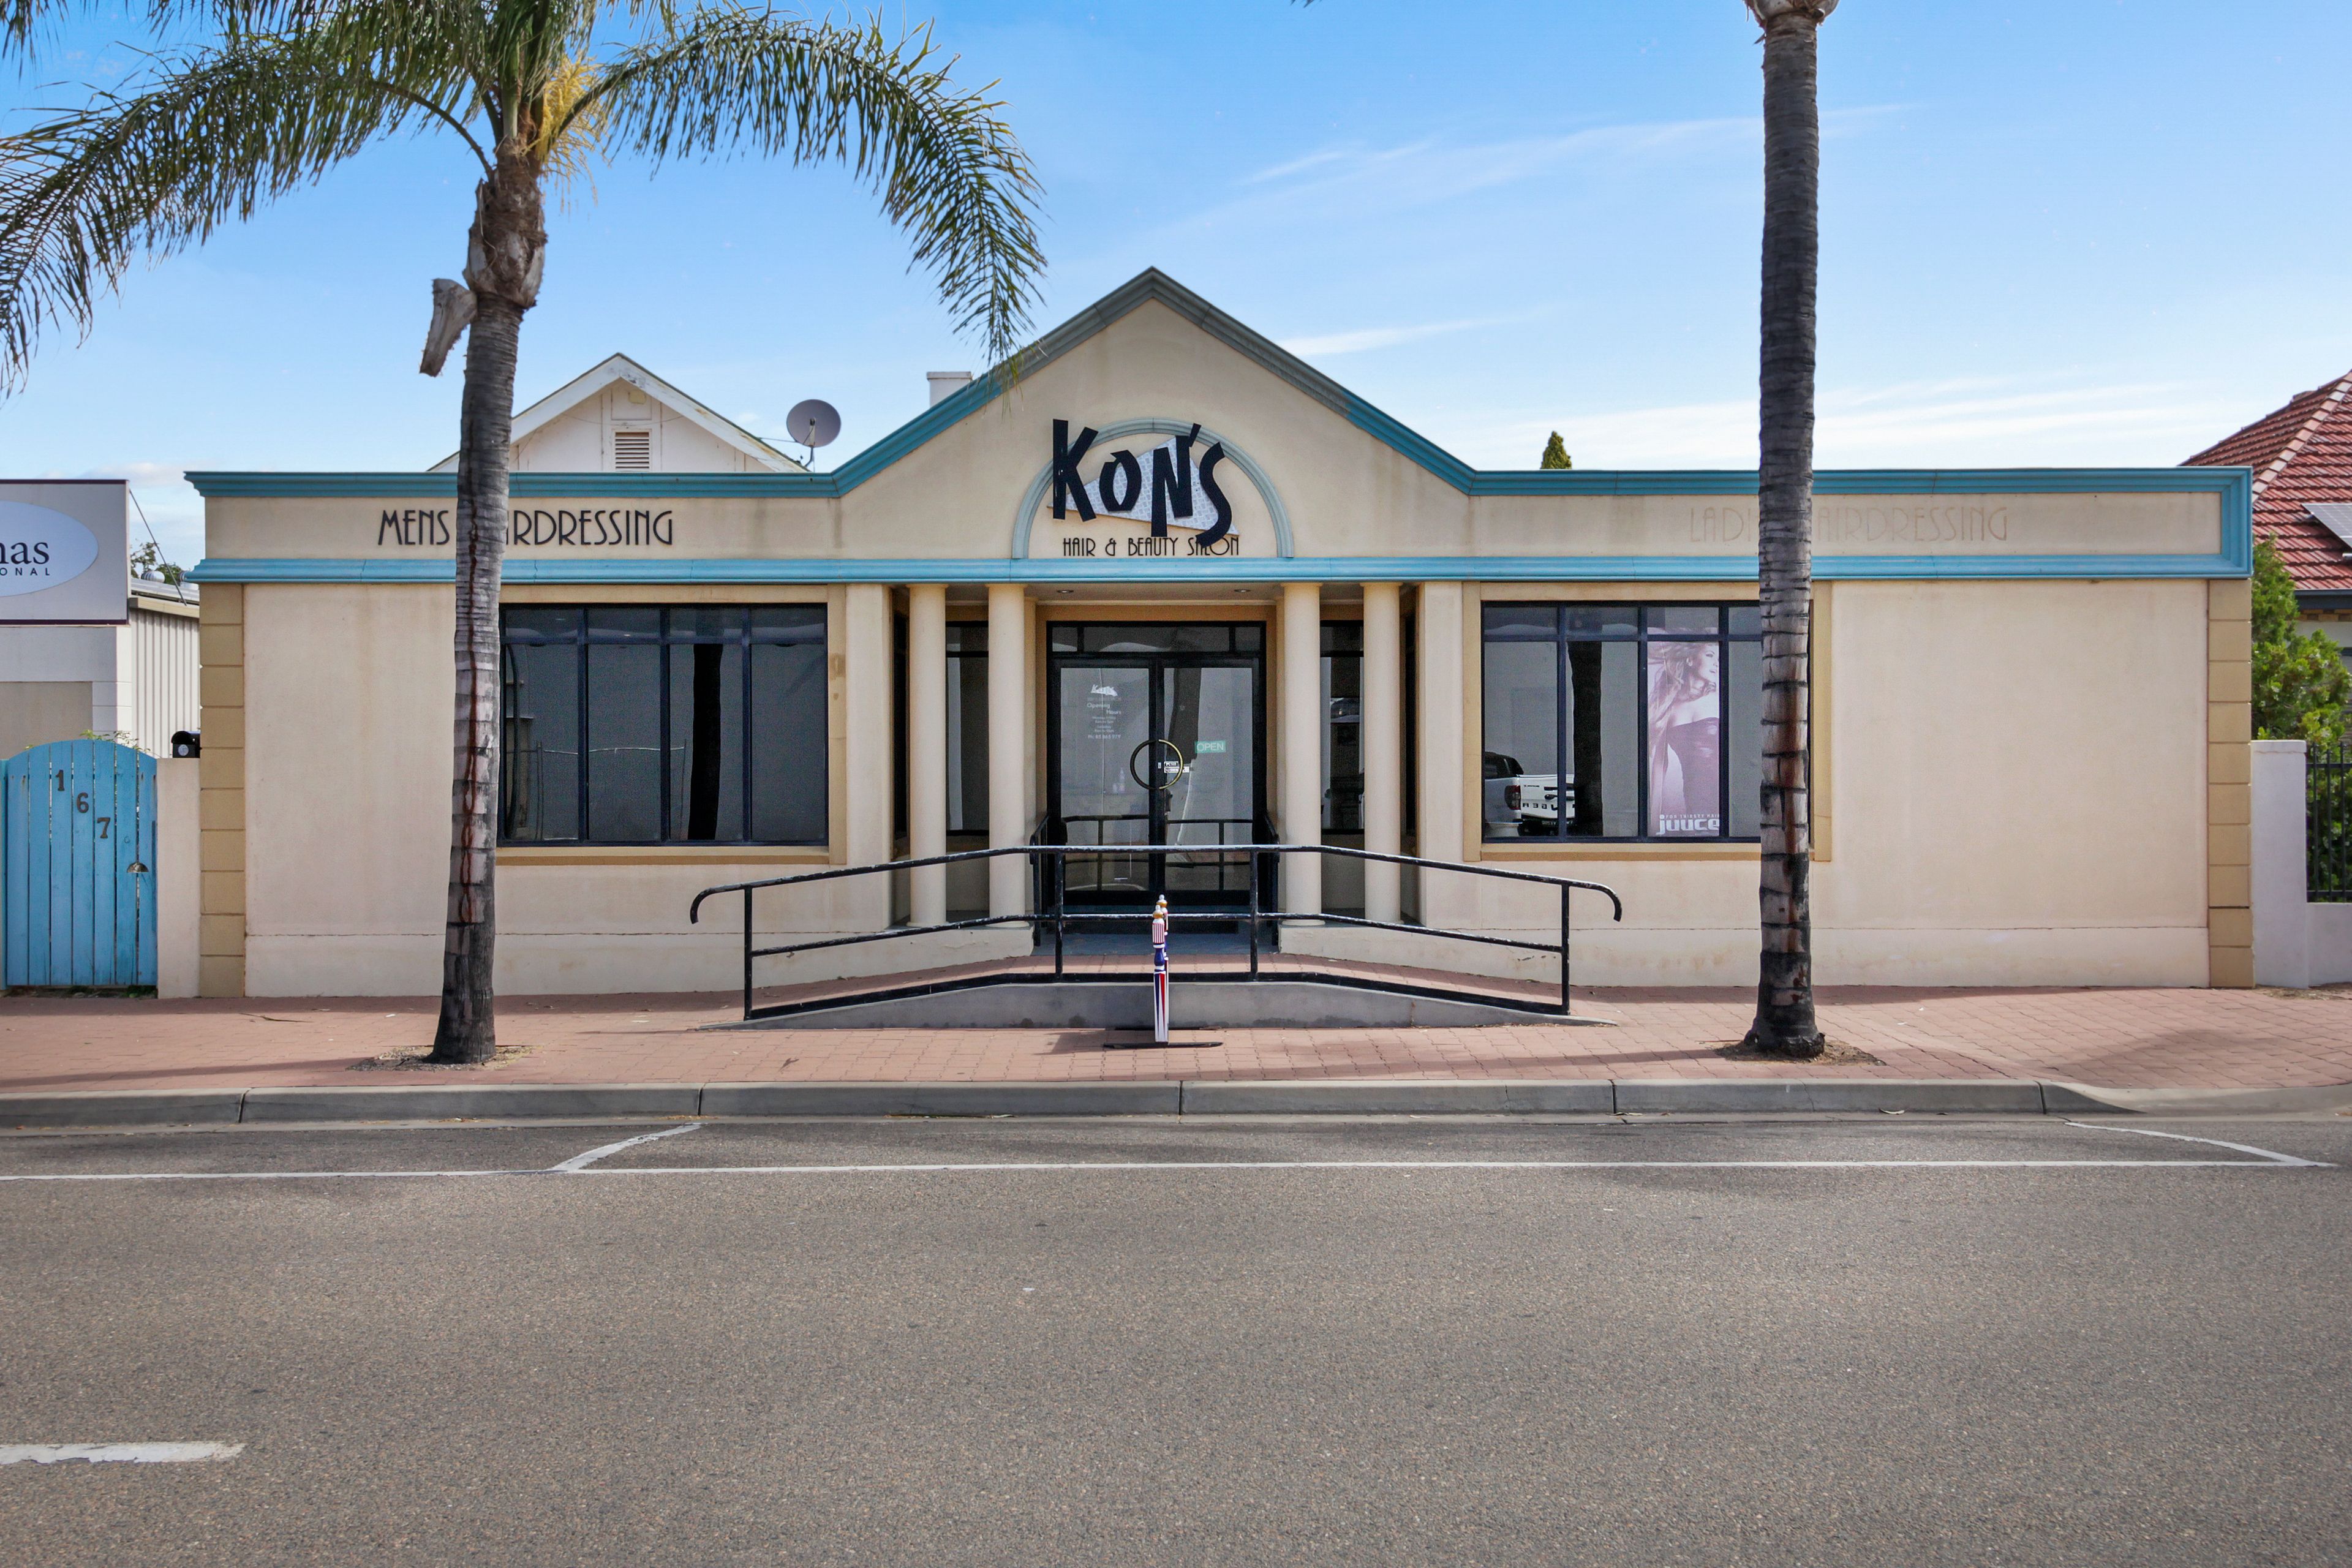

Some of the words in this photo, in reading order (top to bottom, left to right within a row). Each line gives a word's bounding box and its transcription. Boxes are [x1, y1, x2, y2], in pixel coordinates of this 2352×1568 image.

[377, 510, 450, 546] MENS
[506, 510, 673, 546] RDRESSING
[1690, 507, 1752, 542] LADI
[1817, 507, 2008, 542] AIRDRESSING
[1063, 537, 1096, 557] HAIR
[1104, 538, 1117, 556] &
[1128, 537, 1178, 556] BEAUTY
[1196, 742, 1224, 752] OPEN
[1655, 813, 1720, 835] juuce
